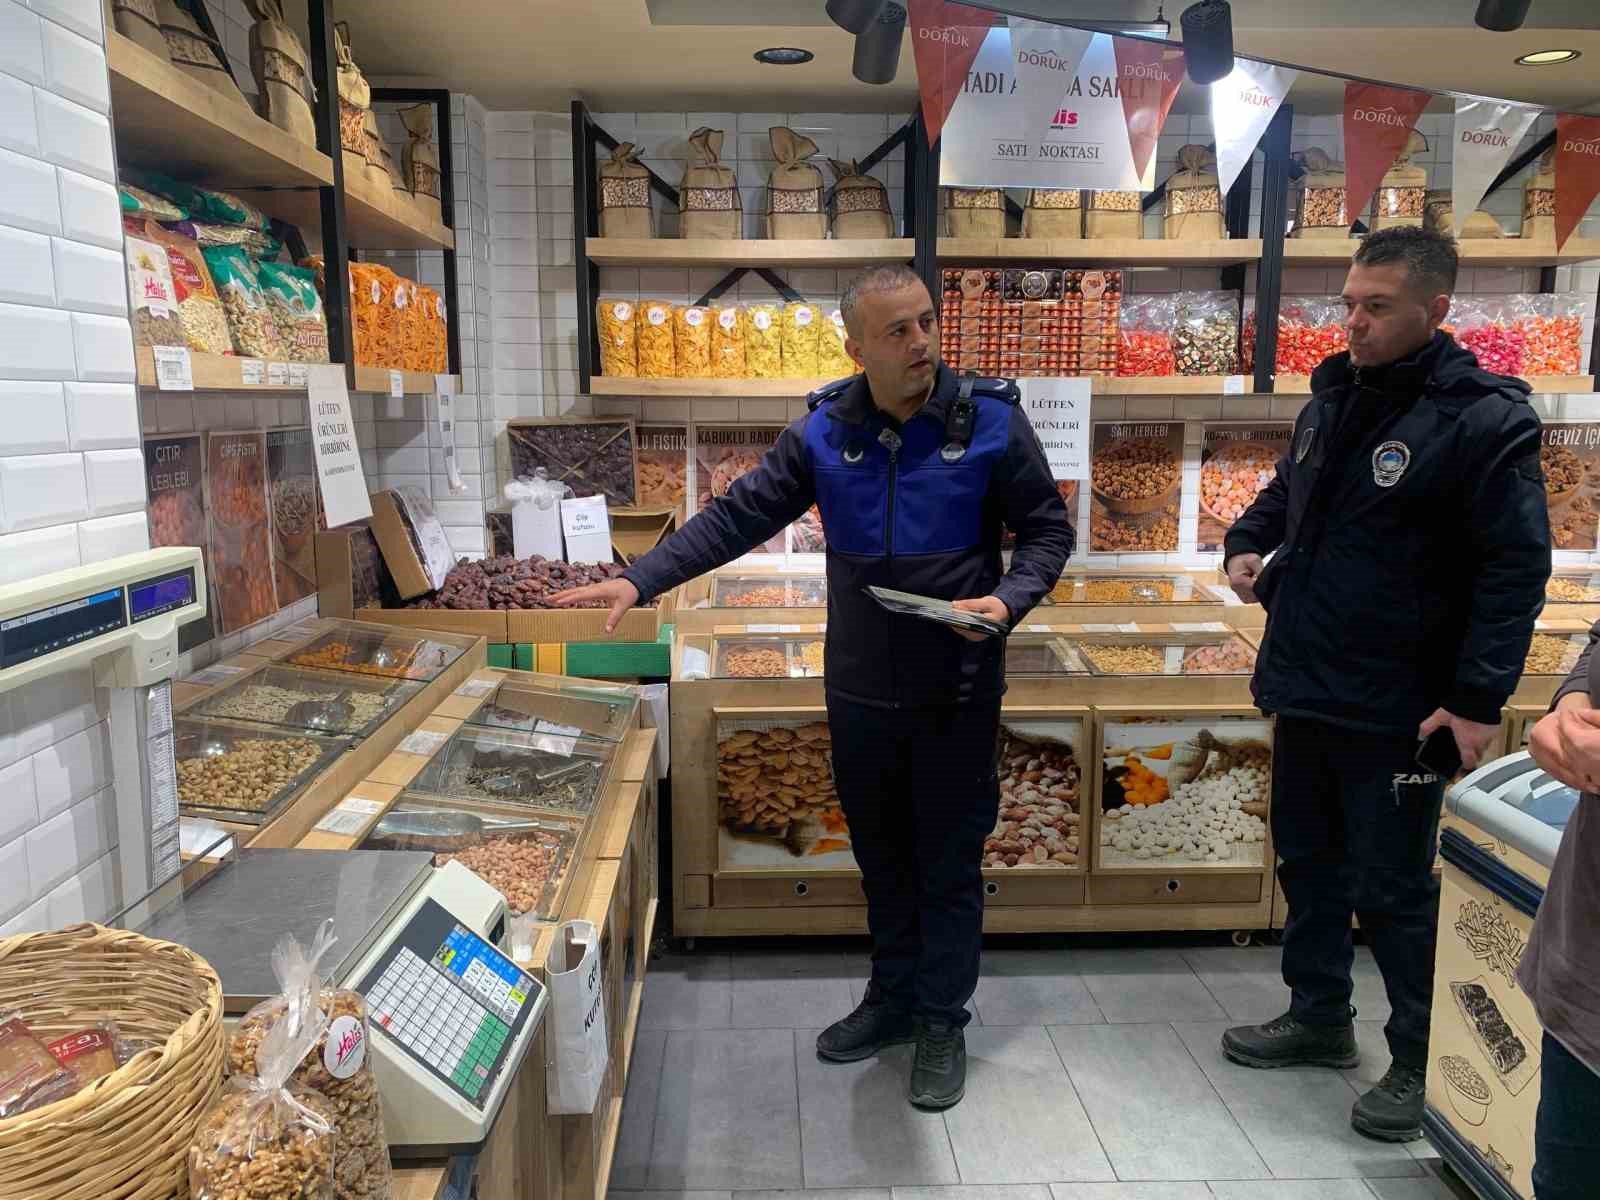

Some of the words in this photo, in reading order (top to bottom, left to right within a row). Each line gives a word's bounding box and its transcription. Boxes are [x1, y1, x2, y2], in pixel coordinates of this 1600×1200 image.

[919, 26, 969, 48] DORUK
[1018, 50, 1068, 72] DORUK
[1124, 64, 1171, 82] DORUK
[1240, 91, 1274, 108] RUK
[1353, 109, 1407, 128] DORUK
[1461, 130, 1512, 147] DORUK
[997, 143, 1029, 158] SATI
[1039, 145, 1100, 160] NOKTASI
[1563, 141, 1600, 156] DORU
[1031, 397, 1077, 410] LÜTFEN
[1033, 417, 1080, 430] RÜNLERİ
[697, 431, 746, 445] KABUKLU
[1549, 427, 1582, 446] CEVİZ
